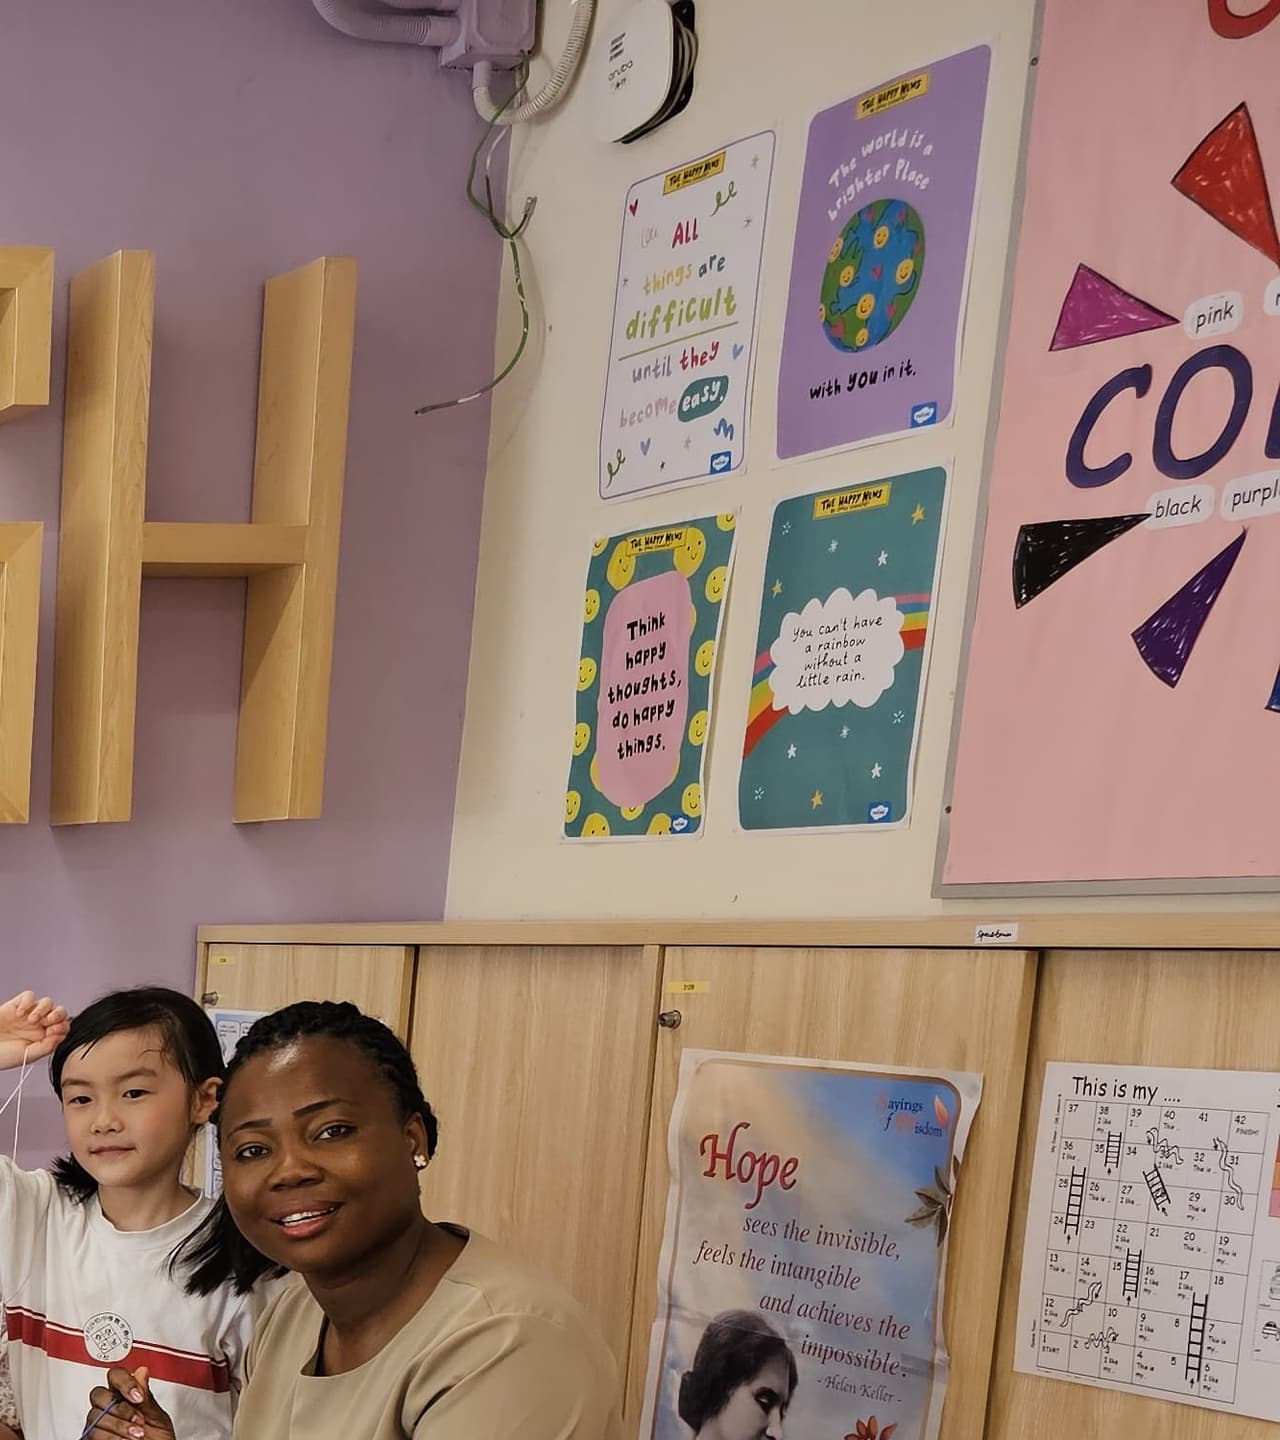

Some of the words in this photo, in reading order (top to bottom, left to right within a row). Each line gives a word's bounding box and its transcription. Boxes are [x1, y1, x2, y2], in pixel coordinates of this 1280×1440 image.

[829, 157, 857, 187] The
[861, 129, 908, 158] world
[909, 129, 925, 148] is
[923, 144, 933, 156] a
[828, 163, 891, 221] brighter
[643, 263, 693, 297] things
[698, 254, 726, 278] are
[625, 285, 737, 341] difficult
[1195, 300, 1235, 334] pink
[632, 355, 672, 384] until
[680, 340, 720, 371] they
[809, 378, 841, 400] with
[846, 370, 879, 392] you
[883, 365, 895, 382] in
[619, 396, 677, 429] become
[682, 380, 724, 412] easy.
[1065, 344, 1280, 489] CO
[838, 492, 862, 506] HAPPY
[1154, 495, 1203, 520] black
[1231, 478, 1280, 513] purpl
[626, 611, 666, 641] Think
[818, 616, 847, 635] can't
[853, 615, 883, 630] have
[625, 641, 666, 671] happy
[805, 644, 812, 653] a
[818, 633, 866, 652] rainbow
[804, 651, 848, 671] without
[854, 654, 861, 663] a
[608, 669, 682, 705] thoughts,
[796, 672, 830, 689] little
[836, 669, 865, 683] rain.
[612, 710, 629, 729] do
[633, 699, 675, 727] happy
[617, 733, 666, 760] things.
[1073, 1075, 1107, 1097] This
[1113, 1076, 1127, 1098] is
[1133, 1082, 1159, 1105] my
[699, 1121, 799, 1210] Hope
[742, 1215, 778, 1237] sees
[783, 1218, 810, 1243] the
[816, 1224, 900, 1261] invisible,
[692, 1240, 736, 1265] feels
[739, 1248, 765, 1272] the
[770, 1254, 861, 1291] intangible
[759, 1294, 795, 1315] and
[797, 1300, 873, 1337] achieves
[878, 1315, 911, 1340] the
[801, 1334, 907, 1378] impossible.
